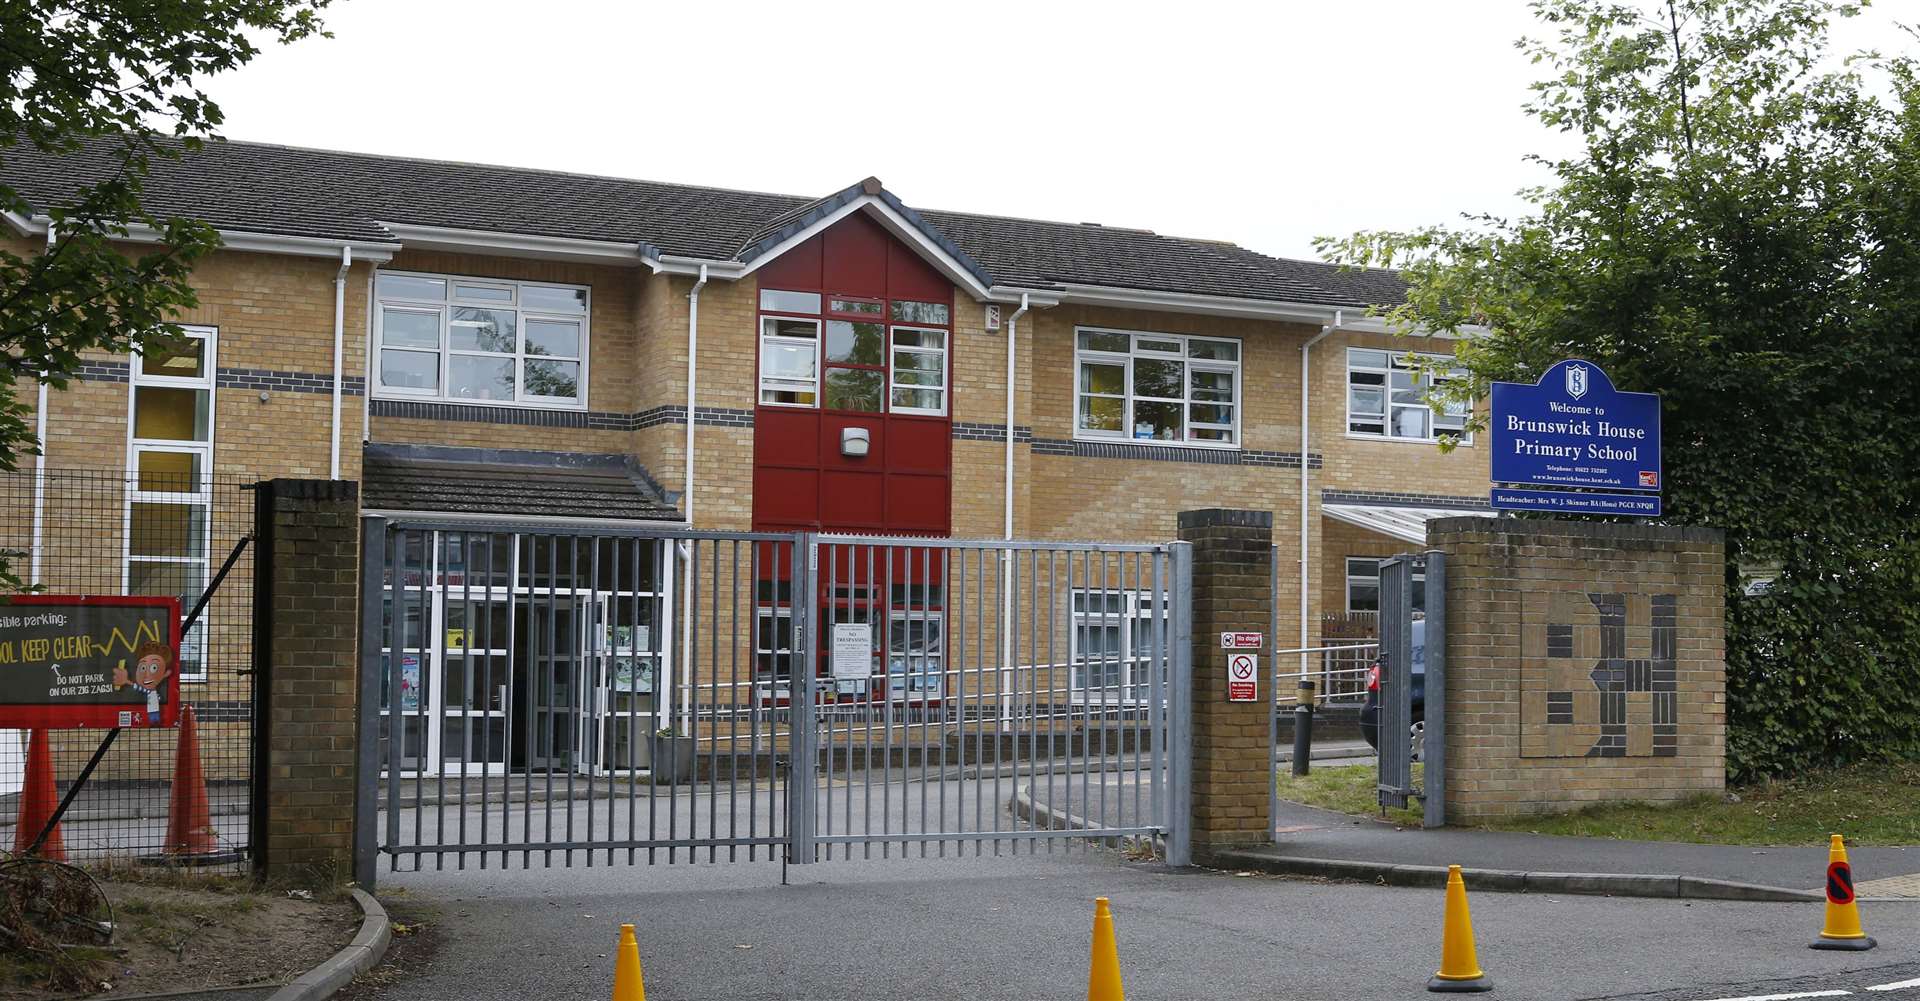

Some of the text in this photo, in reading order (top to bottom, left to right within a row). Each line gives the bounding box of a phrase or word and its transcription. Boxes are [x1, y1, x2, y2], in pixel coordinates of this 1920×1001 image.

[1550, 402, 1604, 415] Welcome to
[1507, 415, 1645, 439] Brunswick House
[1515, 438, 1637, 461] Primary School
[1546, 464, 1573, 472] Telephone:
[1497, 495, 1536, 504] Headteacher:
[1537, 497, 1549, 505] Mrs
[24, 612, 67, 628] parking:
[21, 638, 49, 663] KEEP
[53, 635, 91, 660] CLEAR
[57, 673, 104, 685] DO NOT PARK
[49, 684, 112, 697] ON OUR ZIG ZAGS!
